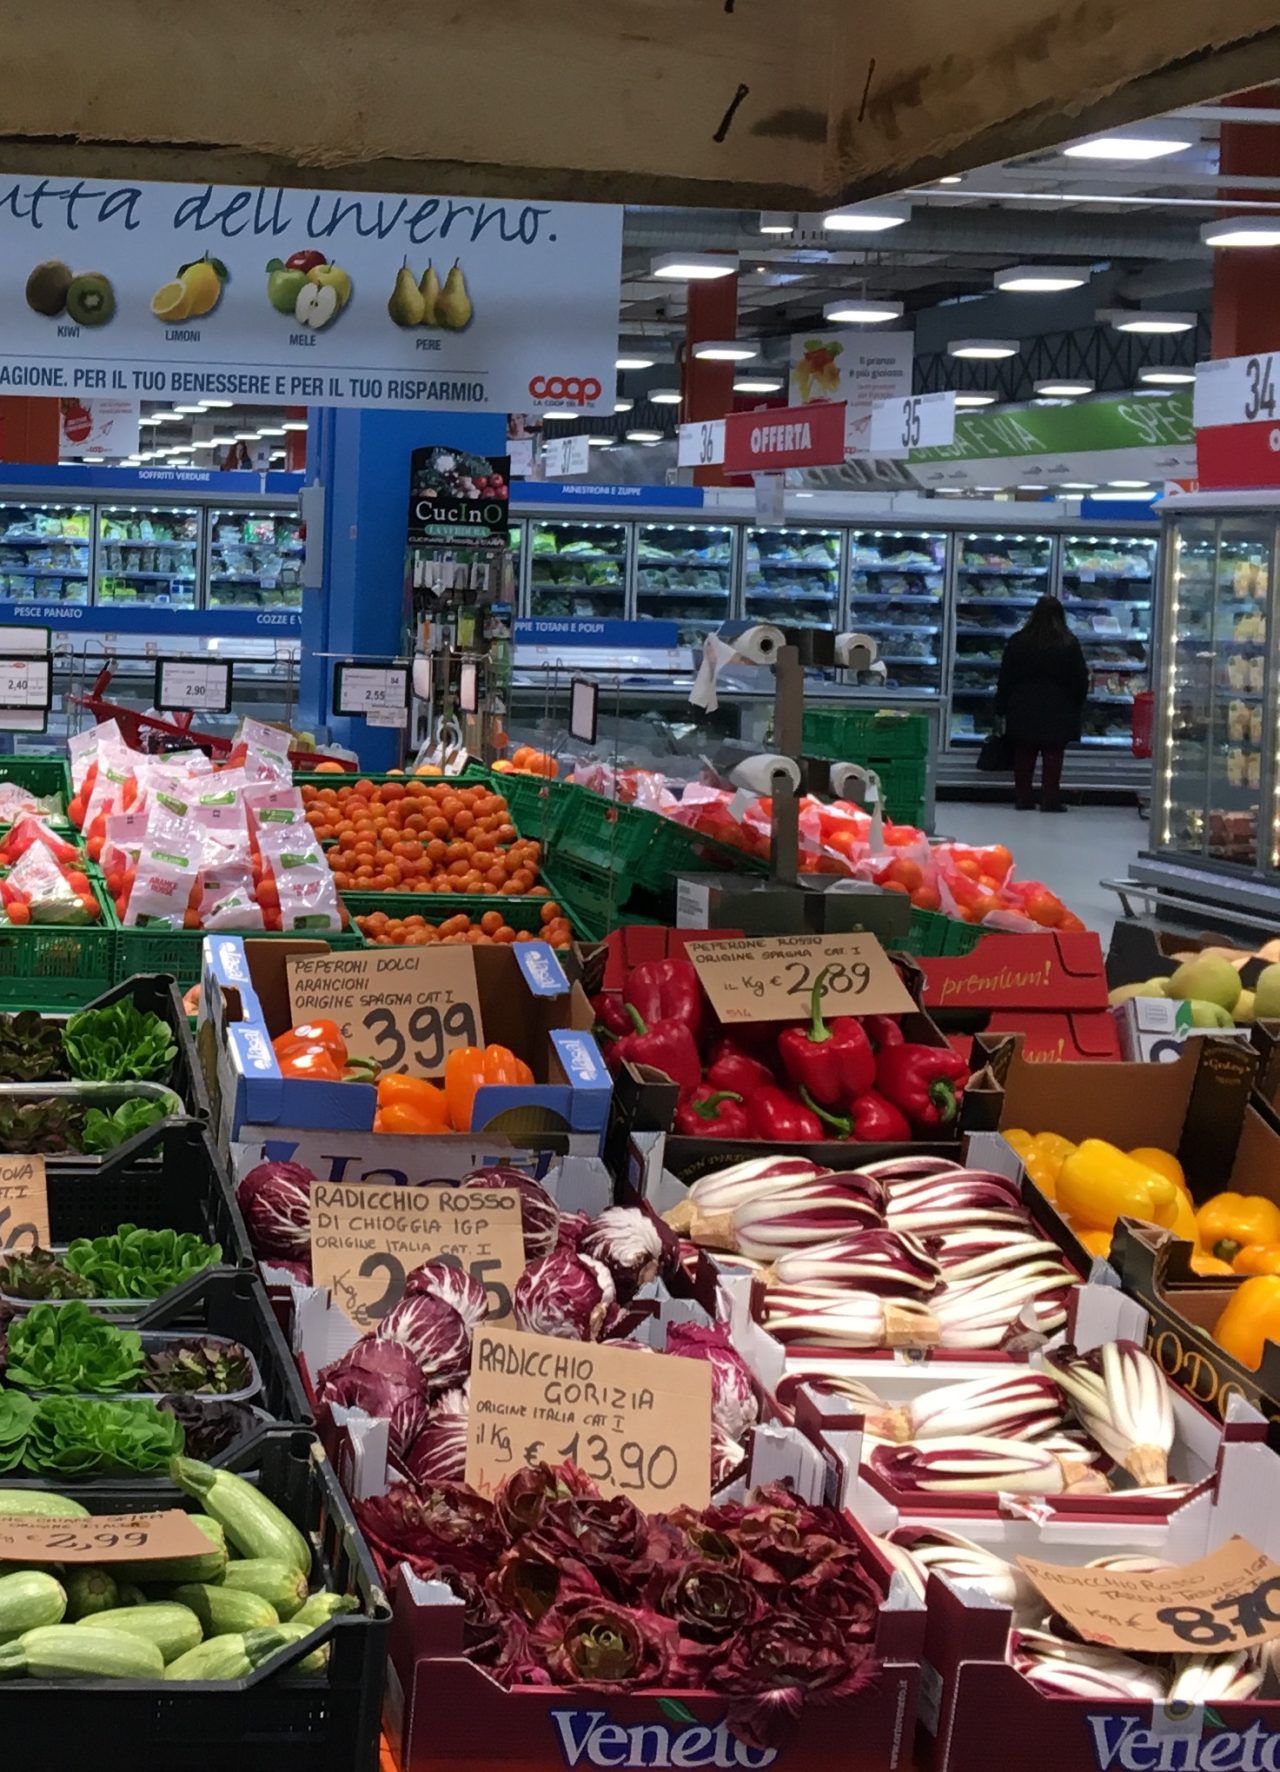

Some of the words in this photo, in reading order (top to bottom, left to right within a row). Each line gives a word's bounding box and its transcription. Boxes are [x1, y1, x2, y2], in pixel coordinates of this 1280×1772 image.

[57, 325, 80, 338] KIWI
[165, 329, 200, 342] LIMONI
[289, 333, 316, 346] MELE
[416, 338, 441, 351] PERE
[73, 369, 108, 388] PER
[112, 370, 126, 389] IL
[133, 371, 166, 391] TUO
[171, 373, 271, 395] BENESSERE
[276, 377, 286, 394] E
[291, 377, 323, 396] PER
[329, 378, 343, 397] IL
[349, 379, 381, 399] TUO
[387, 380, 488, 402] RISPARMIO.
[529, 376, 602, 406] coop
[1245, 357, 1275, 420] 34
[902, 399, 921, 446] 35
[699, 424, 713, 464] 36
[750, 423, 812, 453] OFFERTA
[138, 471, 174, 480] SOFFRITTI
[175, 472, 210, 481] VERDURE
[562, 485, 611, 495] MINESTRONI
[618, 487, 642, 497] ZUPPE
[14, 606, 43, 618] PESCE
[45, 607, 83, 619] PANATO
[256, 614, 287, 625] COZZE
[290, 615, 296, 625] E
[536, 622, 568, 632] TOTANI
[579, 623, 604, 633] POLPI
[690, 938, 767, 952] PEPERONE
[777, 936, 822, 946] ROSSO
[295, 959, 368, 975] PEPERONI
[376, 957, 419, 973] DOLCI
[695, 952, 755, 964] ORIGINE
[762, 949, 812, 960] SPAGNA
[295, 977, 369, 992] ARANCIONI
[742, 976, 765, 998] Kg
[770, 975, 783, 987] €
[940, 960, 1052, 1005] premium!
[295, 995, 354, 1009] ORIGINE
[360, 993, 414, 1008] SPAGNA
[417, 992, 440, 1006] CAT
[341, 1022, 353, 1038] €
[362, 1002, 477, 1074] 3,99
[315, 1185, 430, 1212] RADICCHIO
[440, 1191, 516, 1212] ROSSO
[318, 1216, 339, 1231] DI
[349, 1217, 442, 1234] CHIOGGIA
[454, 1219, 488, 1235] IGP
[316, 1237, 376, 1250] ORIGINE
[386, 1239, 432, 1255] ITALIA
[476, 1243, 491, 1255] I
[332, 1270, 358, 1312] Kg
[351, 1302, 372, 1326] €
[479, 1337, 594, 1380] RADICCHIO
[545, 1382, 655, 1410] GORIZIA
[476, 1401, 527, 1418] ORIGINE
[533, 1406, 576, 1425] ITALIA
[583, 1413, 608, 1429] CAT
[489, 1425, 514, 1463] Kg
[524, 1442, 546, 1467] €
[45, 1531, 149, 1551] 2,99
[1025, 1564, 1138, 1591] RADICCHIO
